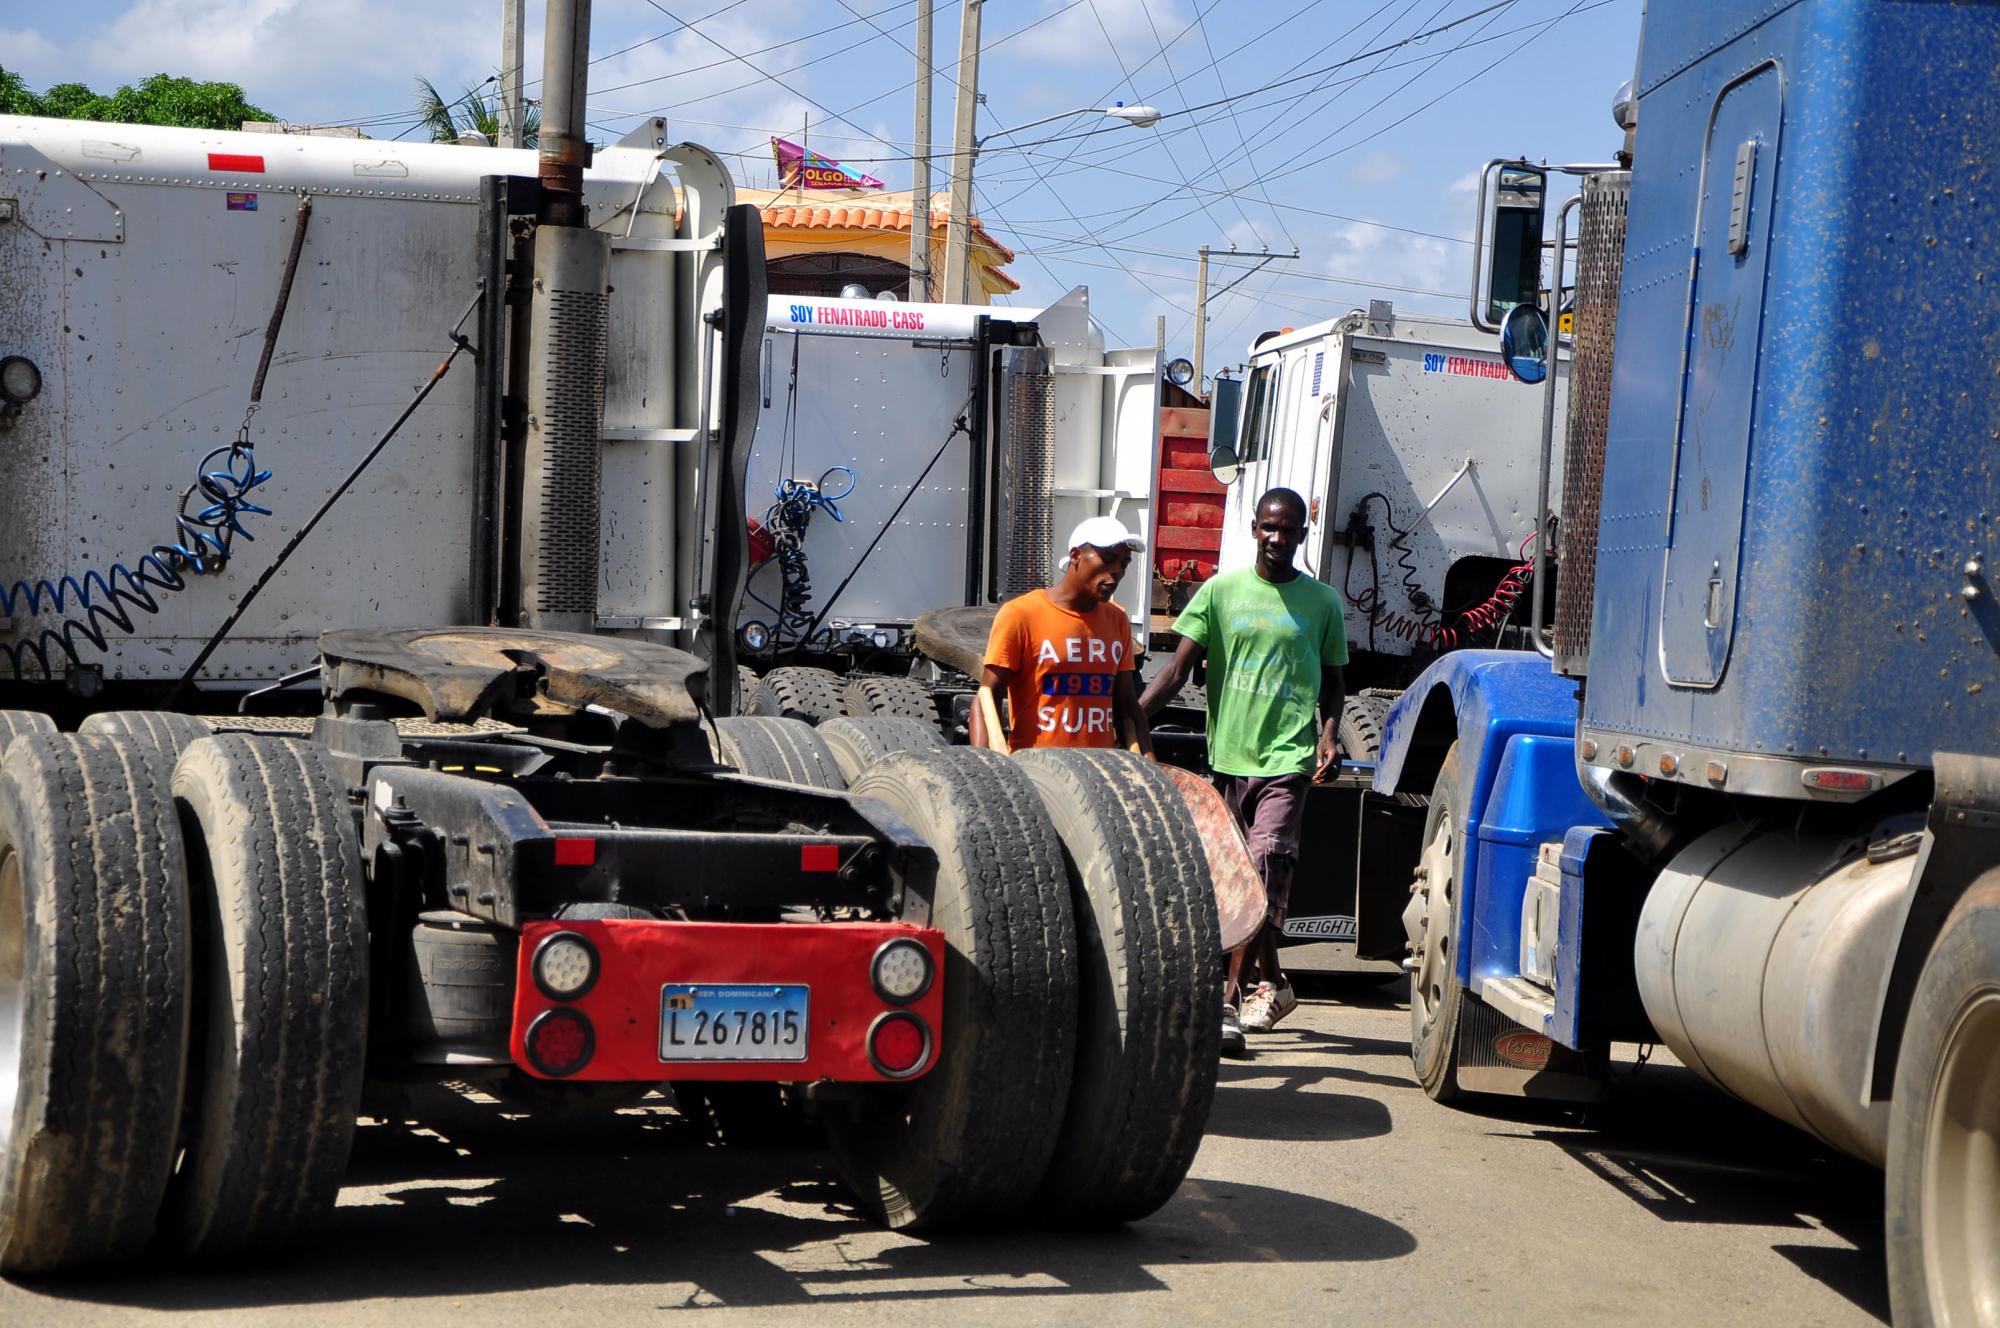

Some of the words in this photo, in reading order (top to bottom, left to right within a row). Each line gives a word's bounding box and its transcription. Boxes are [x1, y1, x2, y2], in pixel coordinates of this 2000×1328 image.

[805, 169, 844, 182] OLGO
[790, 304, 814, 323] SOY
[817, 306, 925, 331] FENATRADO-CASC
[1424, 353, 1446, 373] SOY
[1038, 637, 1124, 665] AERO
